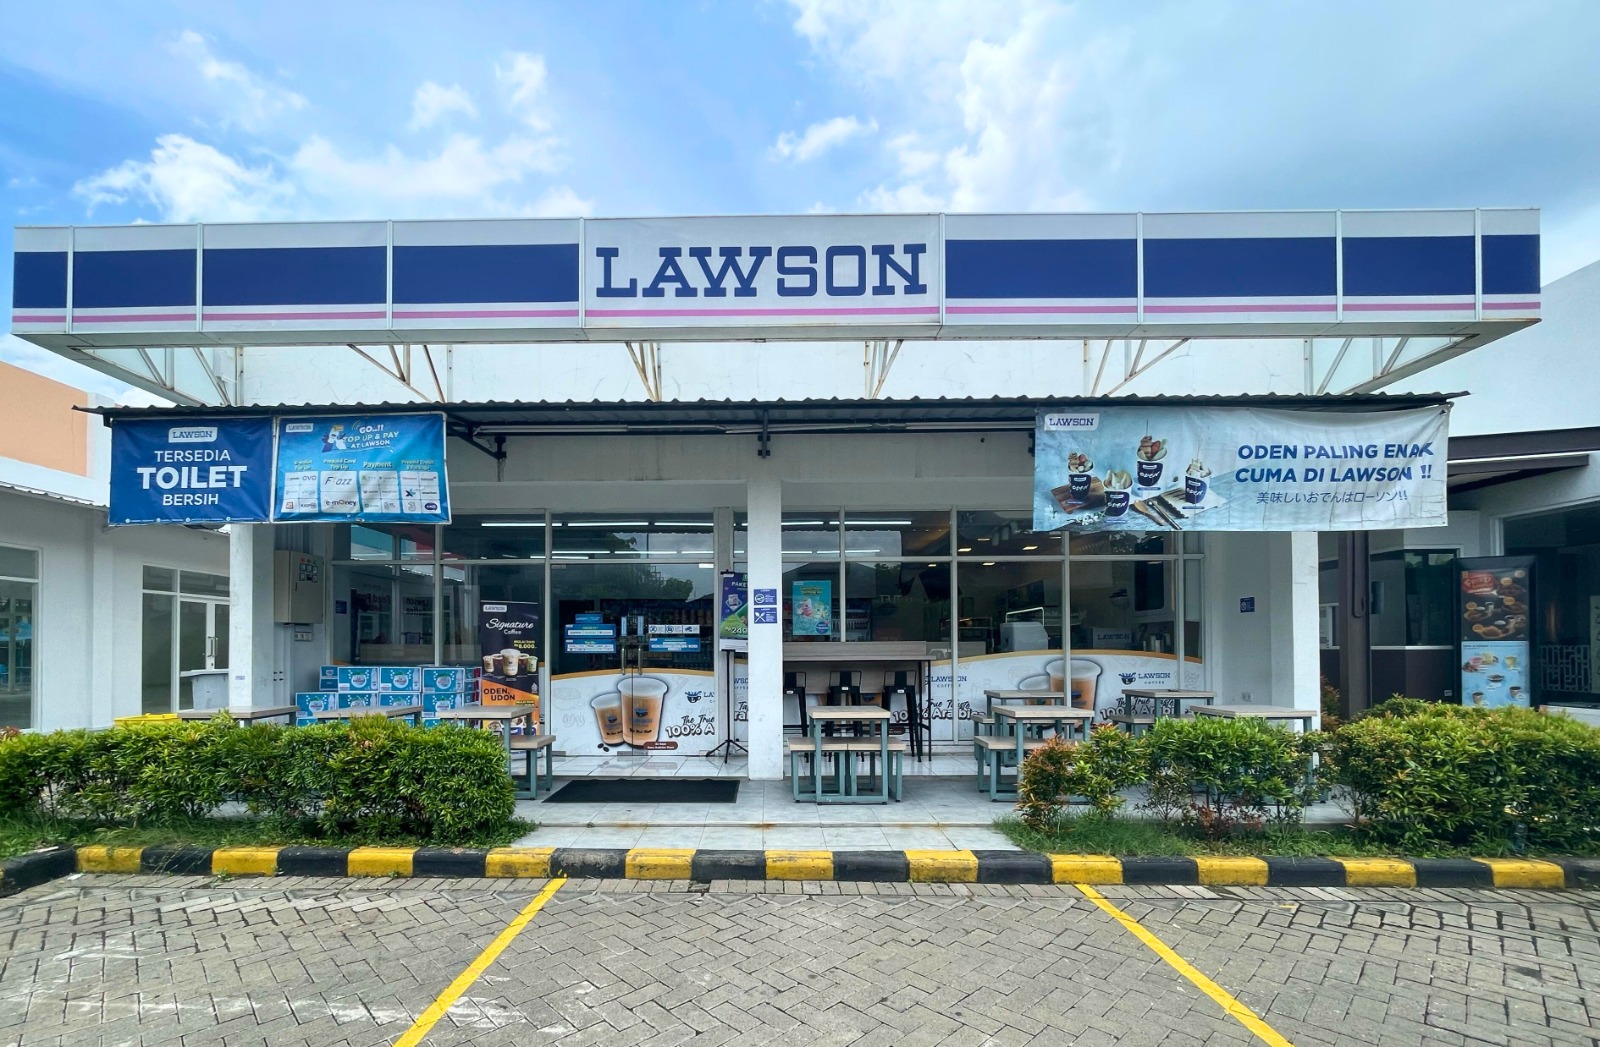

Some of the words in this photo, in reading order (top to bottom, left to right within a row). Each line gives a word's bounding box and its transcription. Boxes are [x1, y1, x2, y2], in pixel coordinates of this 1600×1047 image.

[596, 244, 927, 298] LAWSON
[1049, 417, 1094, 426] LAWSON
[172, 430, 212, 439] LAWSON
[361, 440, 391, 448] LAWSON
[154, 450, 231, 463] TERSEDIA
[1238, 444, 1297, 459] ODEN
[1304, 444, 1378, 459] PALING
[1384, 442, 1434, 458] ENAK
[137, 465, 248, 490] TOILET
[1235, 467, 1297, 483] CUMA
[1303, 468, 1325, 482] DI
[1330, 466, 1413, 482] LAWSON
[1420, 464, 1432, 479] !!
[163, 494, 219, 506] BERSIH
[486, 618, 534, 630] Signature
[682, 714, 694, 724] The
[699, 714, 714, 723] True
[666, 724, 701, 738] 100%
